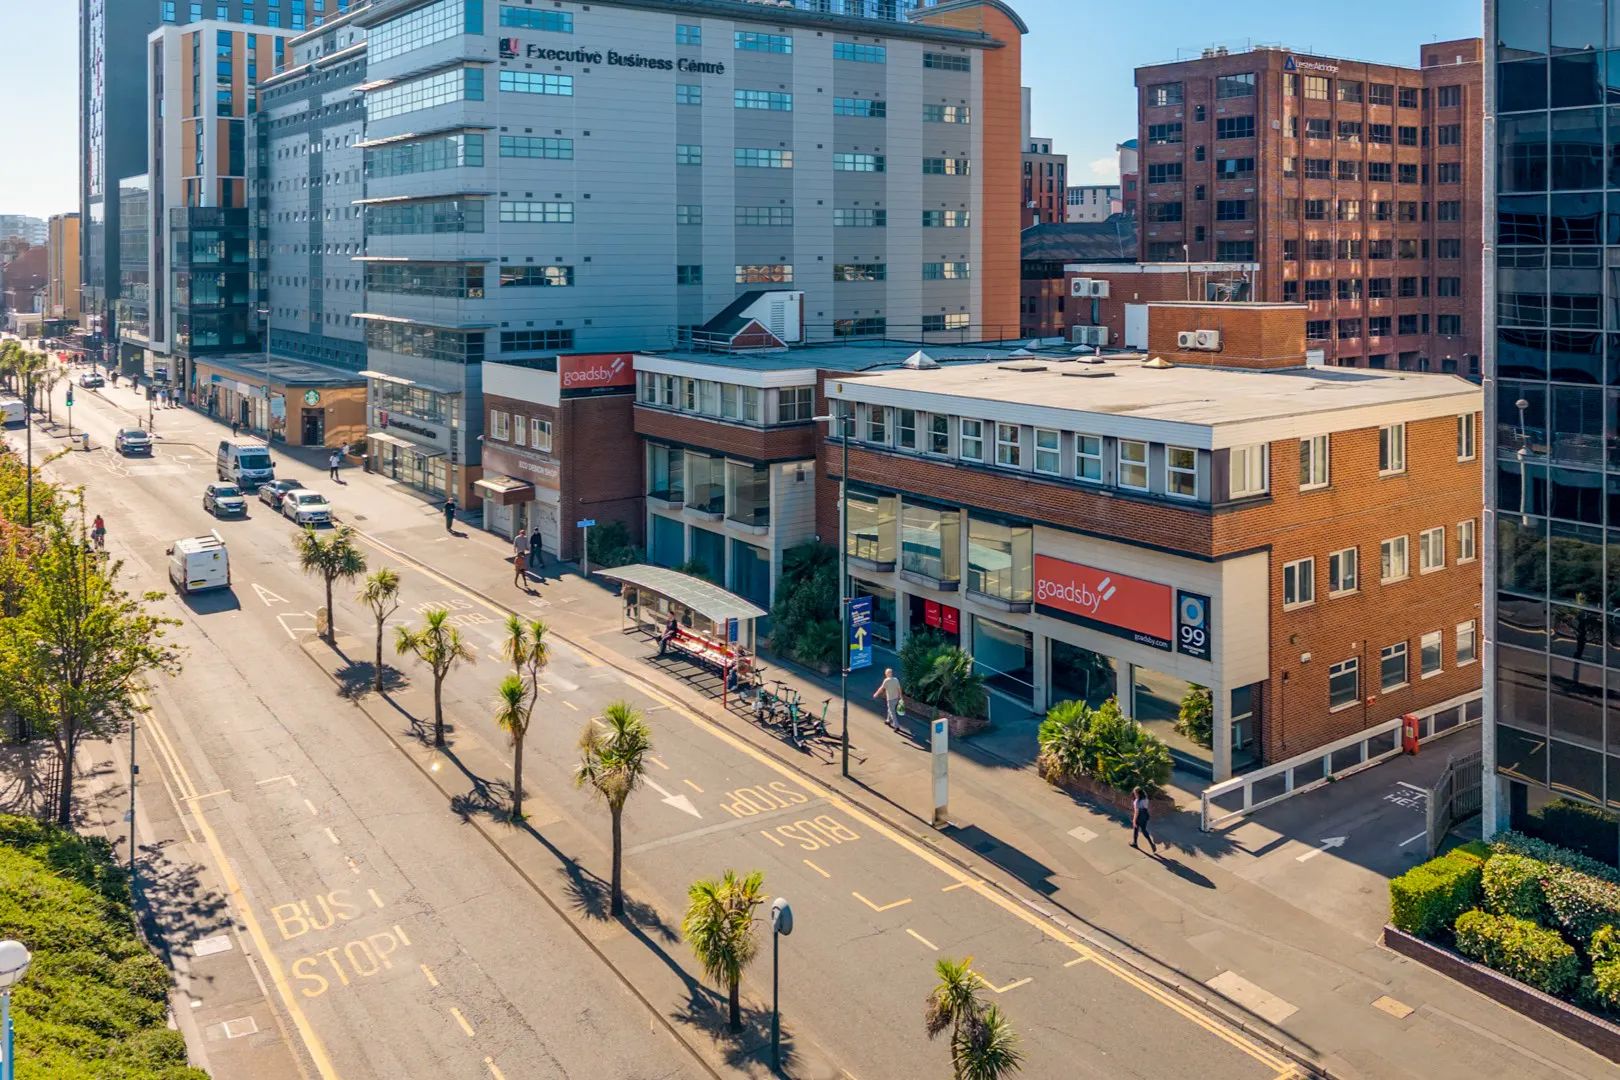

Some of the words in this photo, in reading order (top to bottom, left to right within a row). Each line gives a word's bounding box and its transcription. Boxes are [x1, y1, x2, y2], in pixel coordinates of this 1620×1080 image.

[526, 43, 602, 65] Executive
[607, 48, 673, 71] Business
[677, 57, 725, 75] Centre
[563, 365, 615, 386] goadsby
[1037, 578, 1101, 614] goadsby
[1134, 633, 1168, 648] goadsby.com
[1181, 626, 1205, 646] 99
[725, 781, 809, 816] STOP
[775, 814, 861, 851] BUS
[270, 889, 361, 941] BUS
[291, 932, 397, 998] STOP
